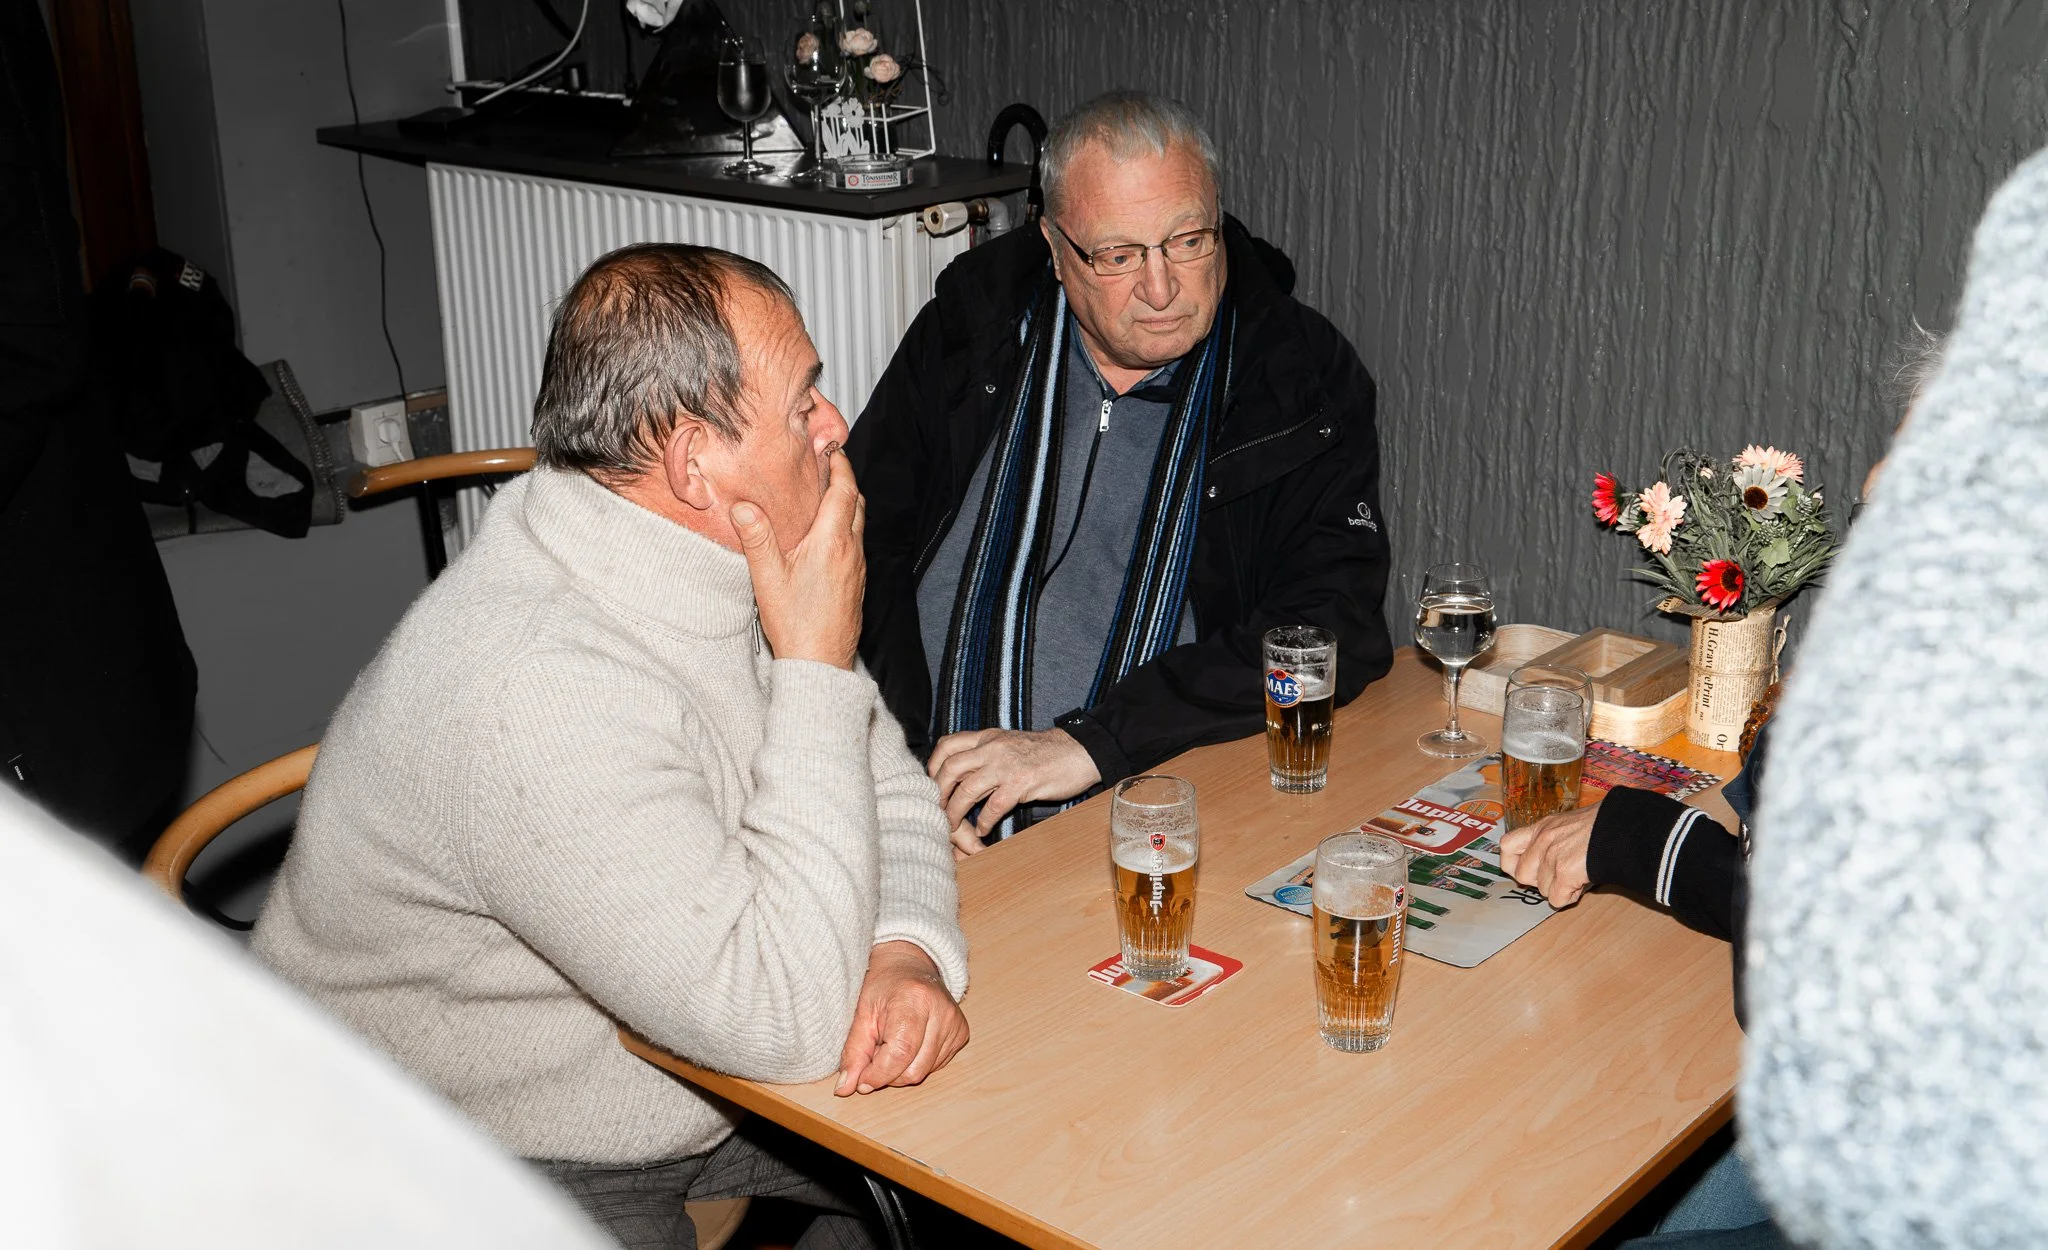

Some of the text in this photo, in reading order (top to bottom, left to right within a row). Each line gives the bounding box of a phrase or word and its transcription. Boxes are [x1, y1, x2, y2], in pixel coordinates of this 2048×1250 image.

[1265, 676, 1302, 697] MAES
[1396, 799, 1497, 831] Jupiler
[1149, 850, 1165, 909] Jupiler
[1388, 911, 1403, 968] Jupiler
